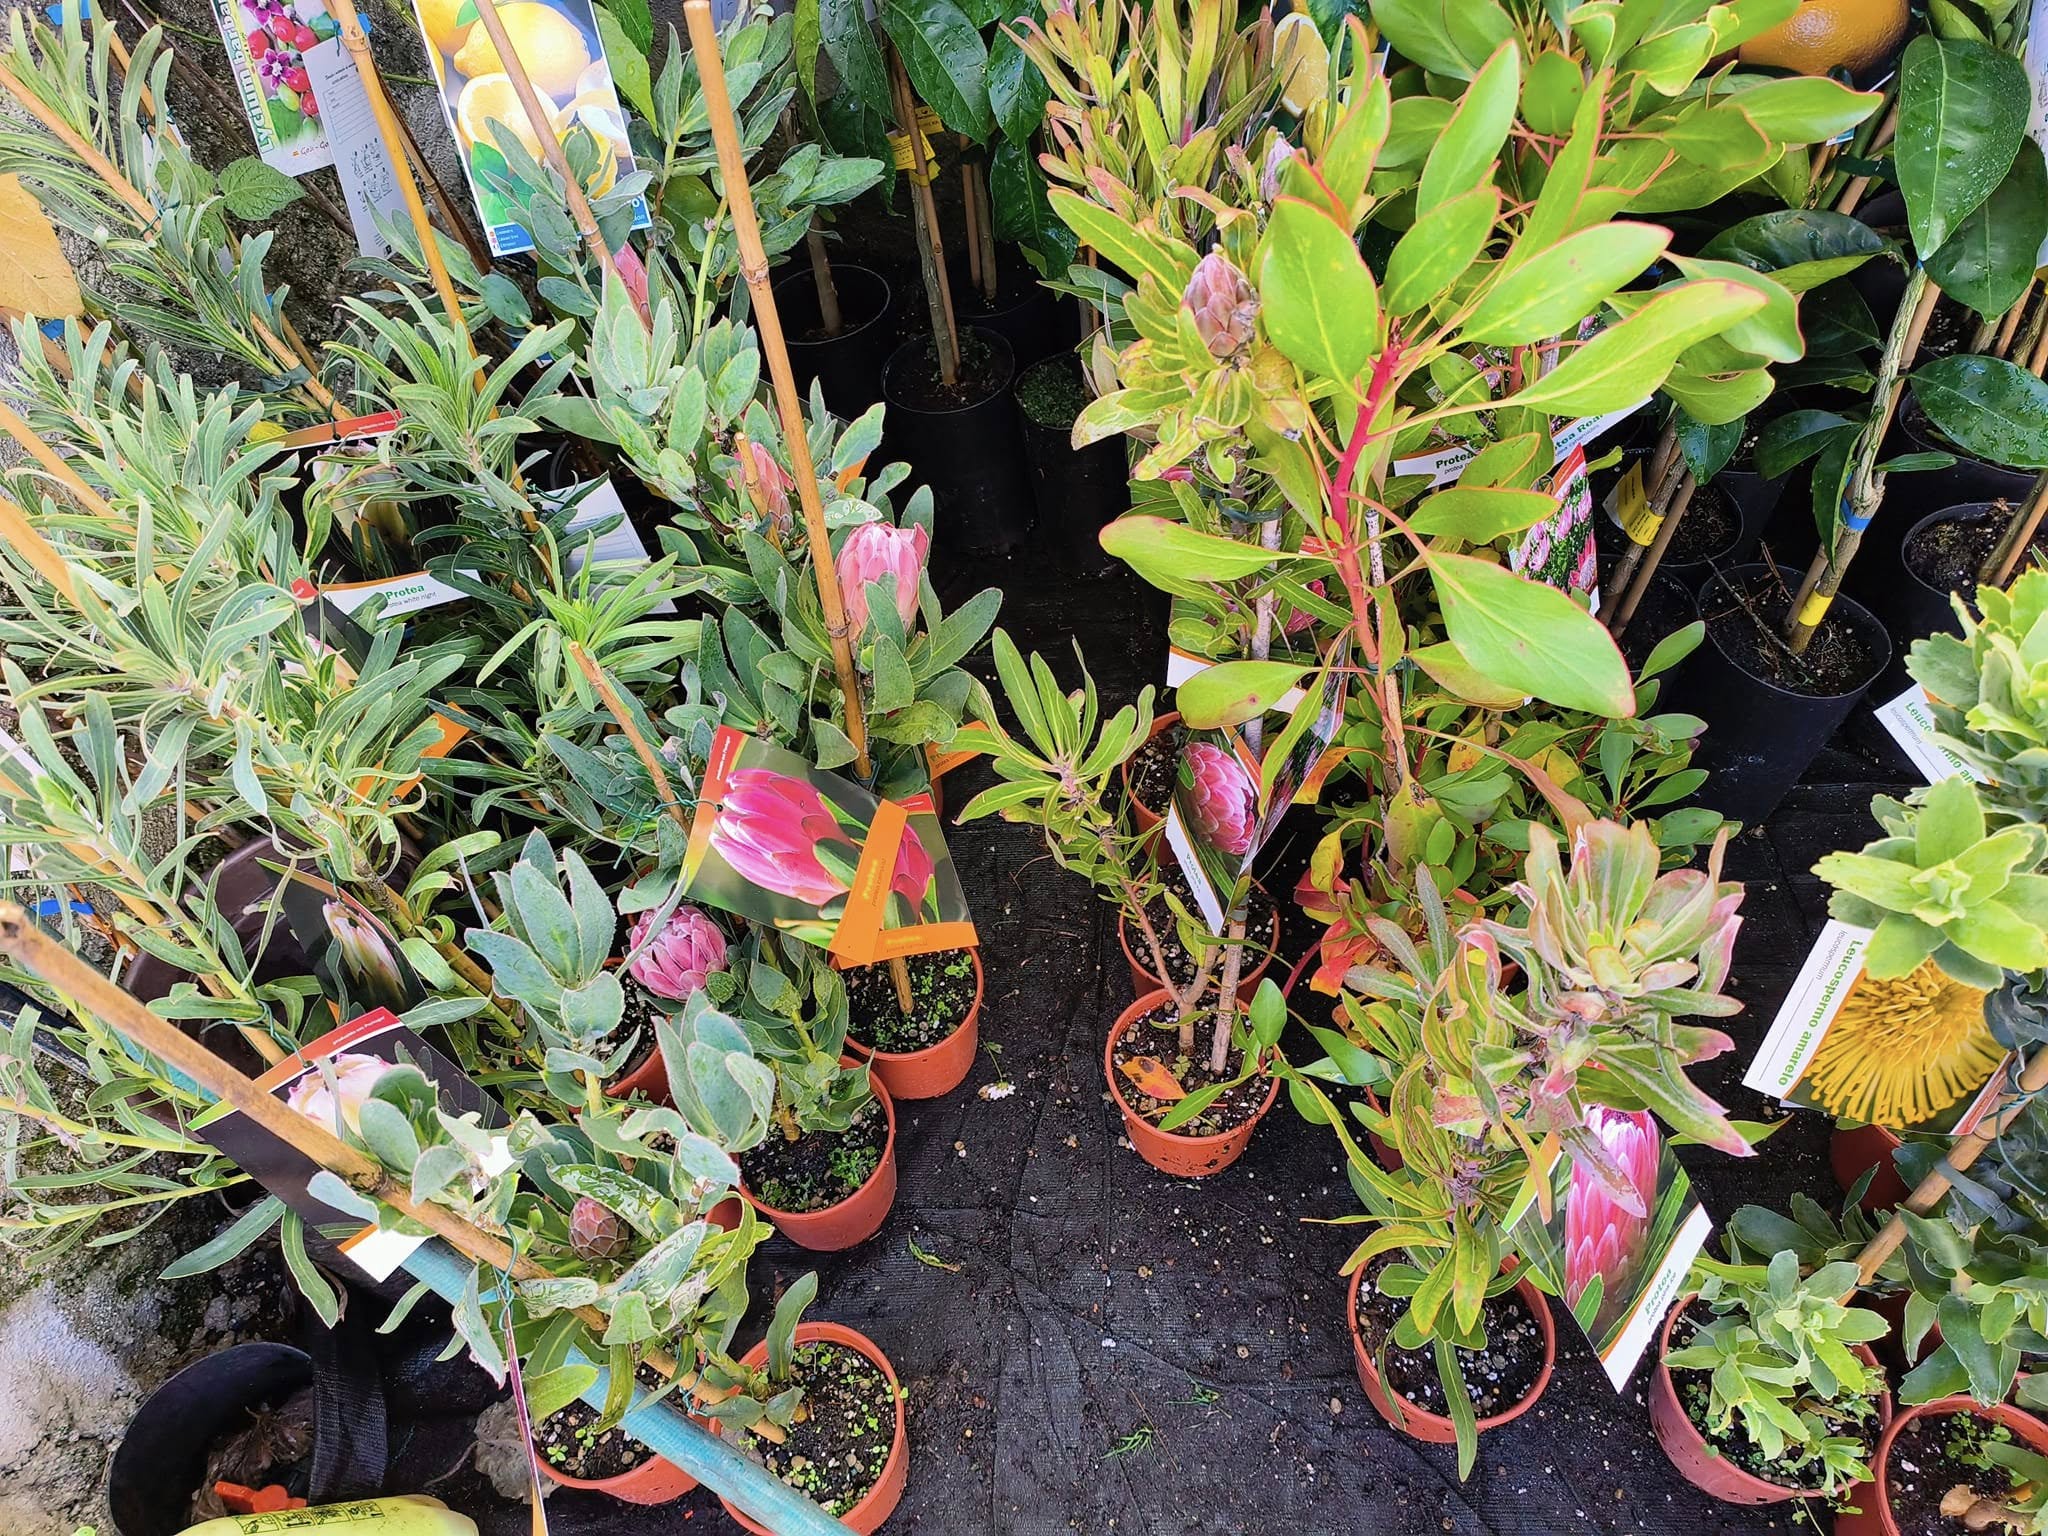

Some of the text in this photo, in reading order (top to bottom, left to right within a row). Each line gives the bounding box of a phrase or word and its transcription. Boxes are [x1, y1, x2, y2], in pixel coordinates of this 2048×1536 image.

[239, 67, 275, 154] Lycium
[1577, 414, 1603, 432] Rea
[1435, 452, 1474, 469] Protea
[385, 584, 425, 600] Protea
[1815, 930, 1849, 981] leucospermum
[1778, 939, 1864, 1087] Leucospermo amarelo
[1645, 1269, 1672, 1315] Protea
